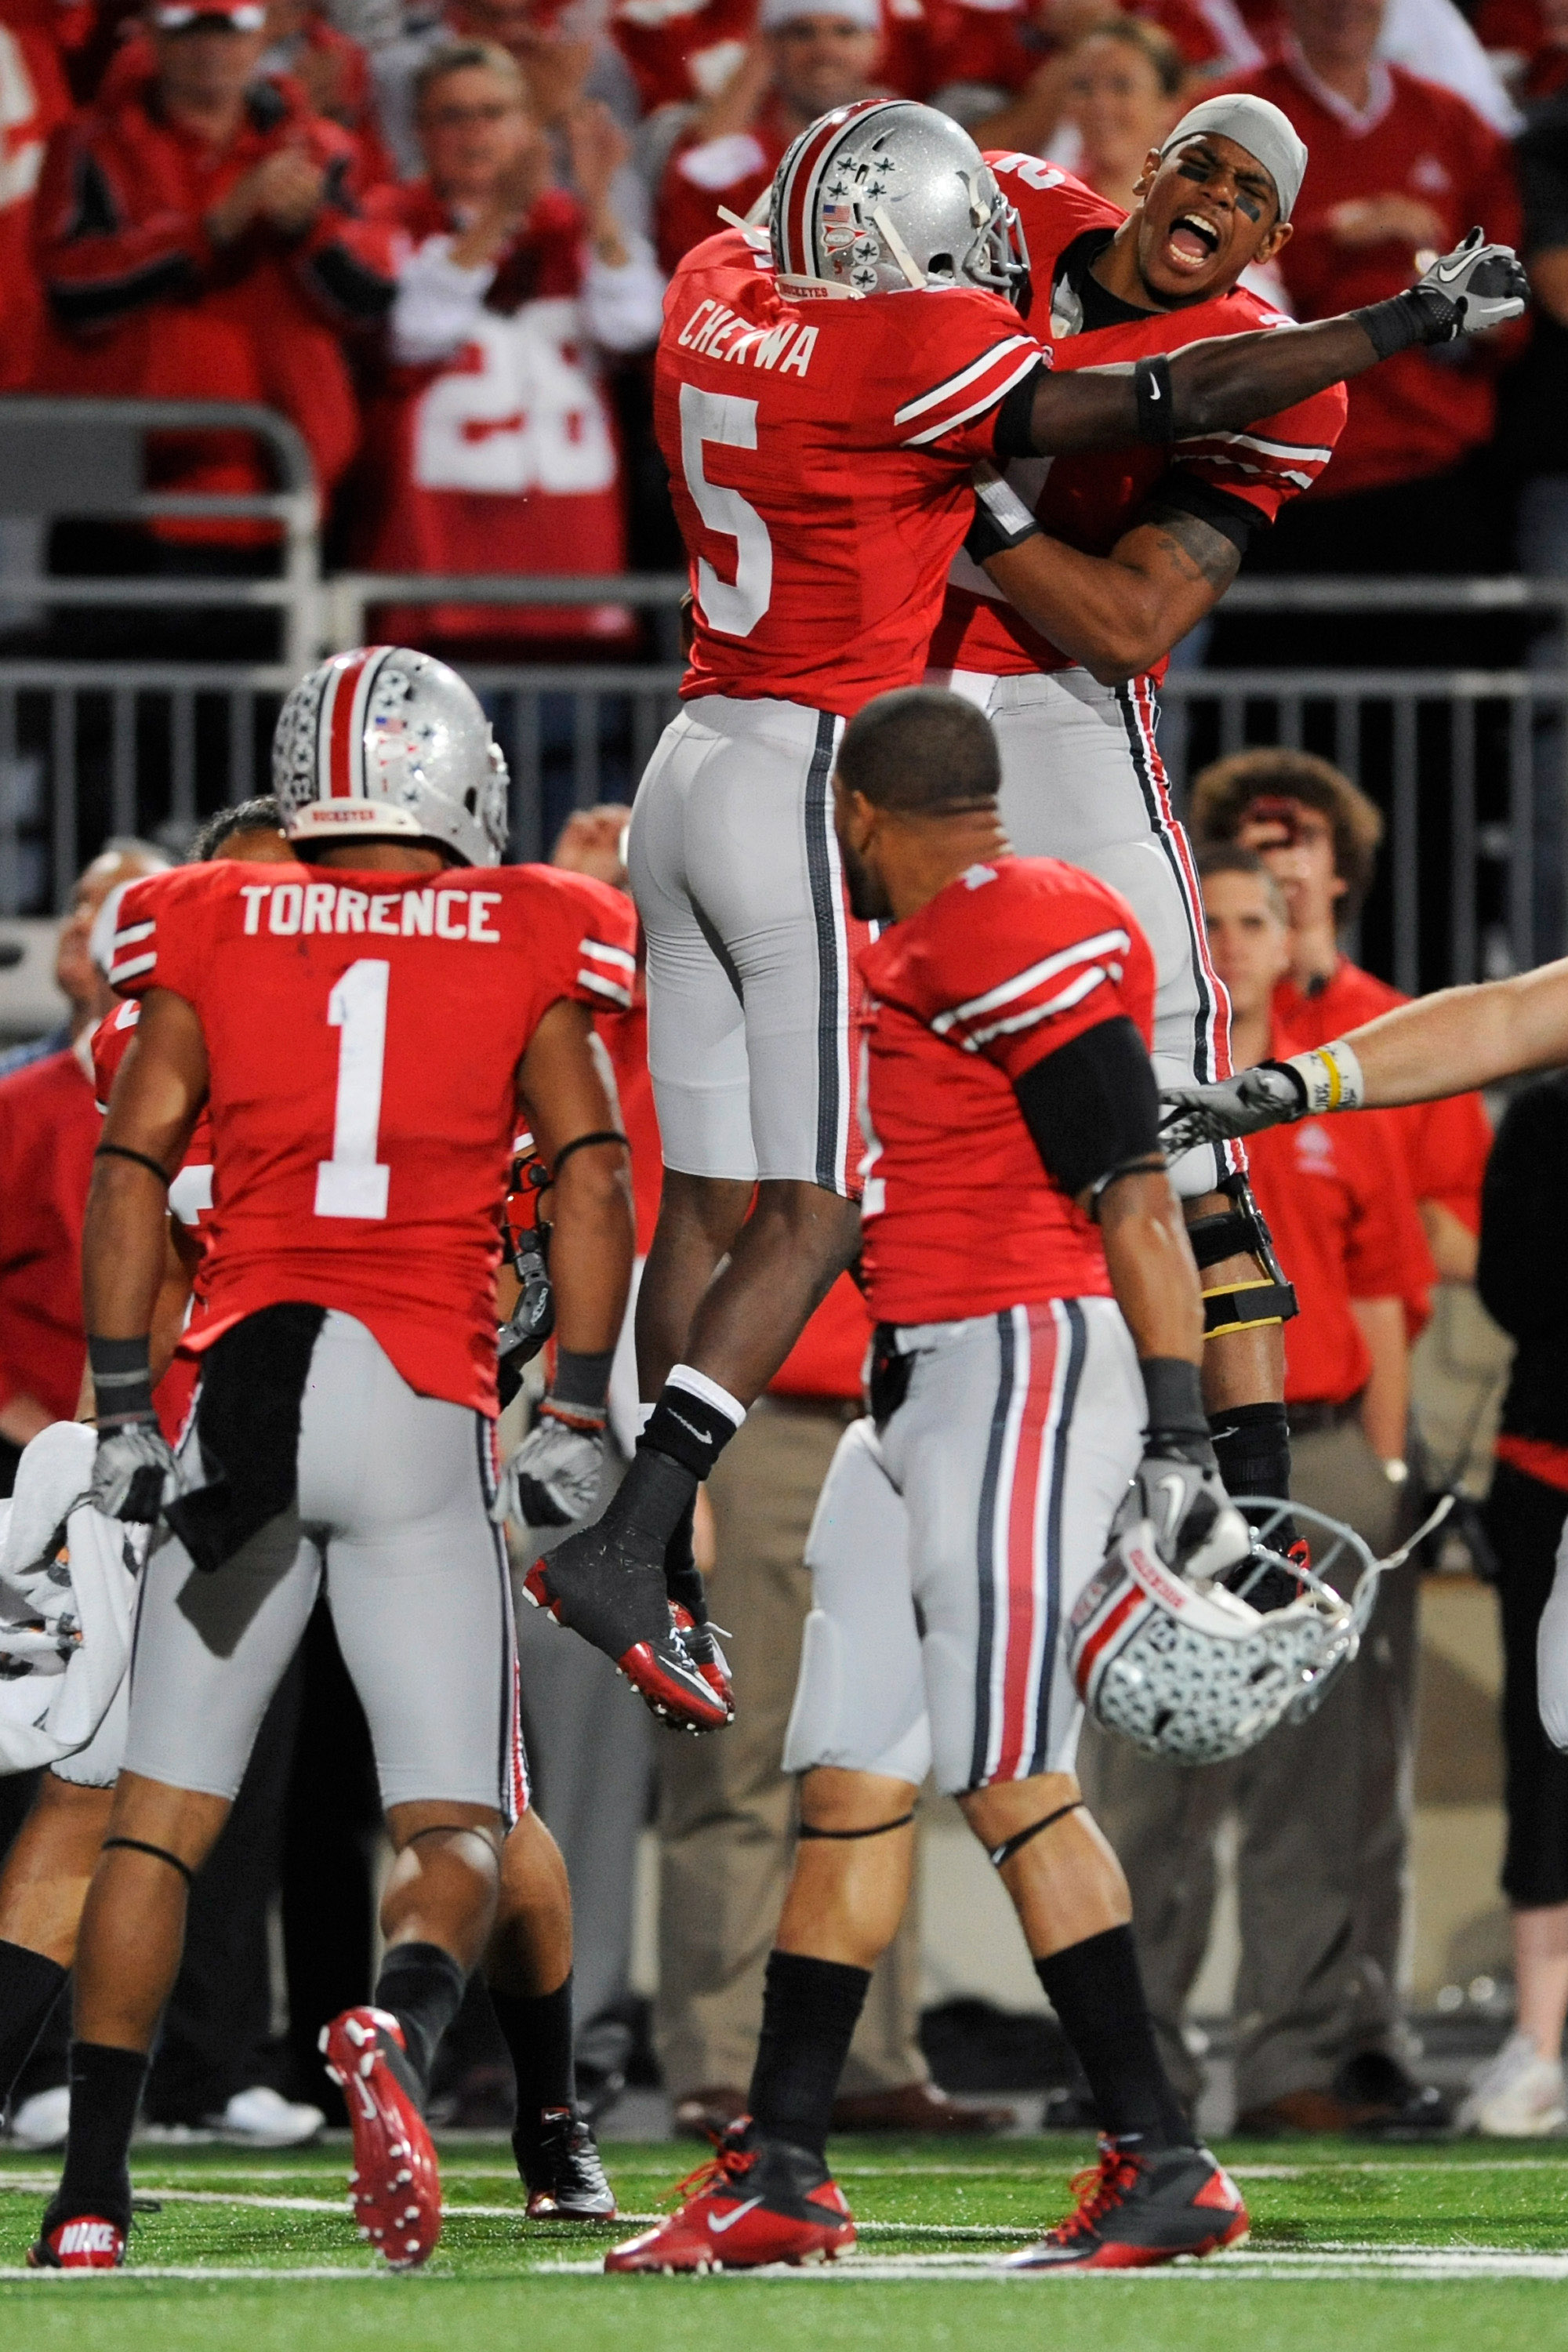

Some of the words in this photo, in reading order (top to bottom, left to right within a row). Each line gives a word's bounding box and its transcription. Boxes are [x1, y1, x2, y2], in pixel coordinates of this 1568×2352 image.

[833, 260, 843, 274] 5
[680, 382, 772, 637] 5
[240, 884, 502, 943] TORRENCE
[314, 959, 390, 1220] 1
[58, 2222, 115, 2256] NIKE
